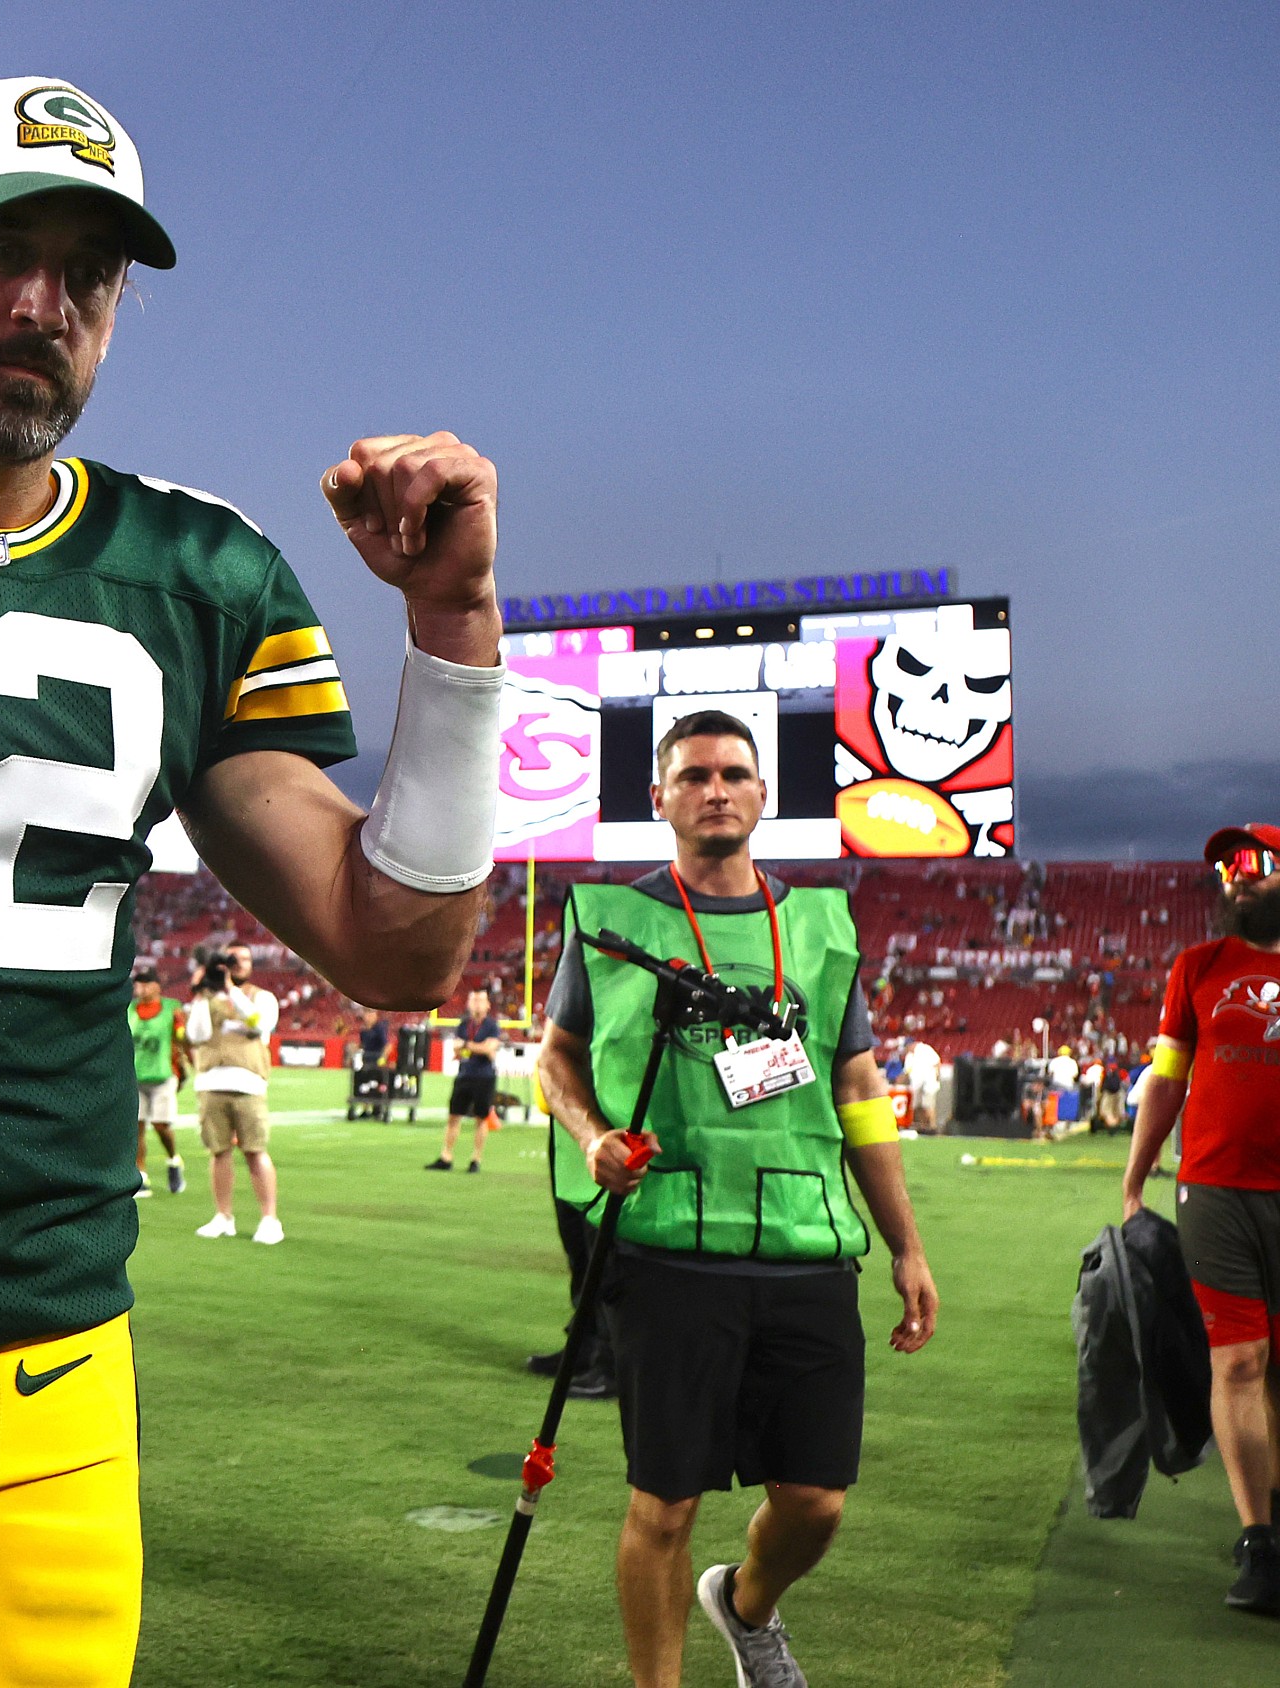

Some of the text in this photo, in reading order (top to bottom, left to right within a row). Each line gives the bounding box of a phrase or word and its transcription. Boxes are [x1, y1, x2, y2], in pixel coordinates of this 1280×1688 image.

[22, 126, 86, 143] PACKERS
[504, 567, 949, 624] RAYMOND JAMES STADIUM
